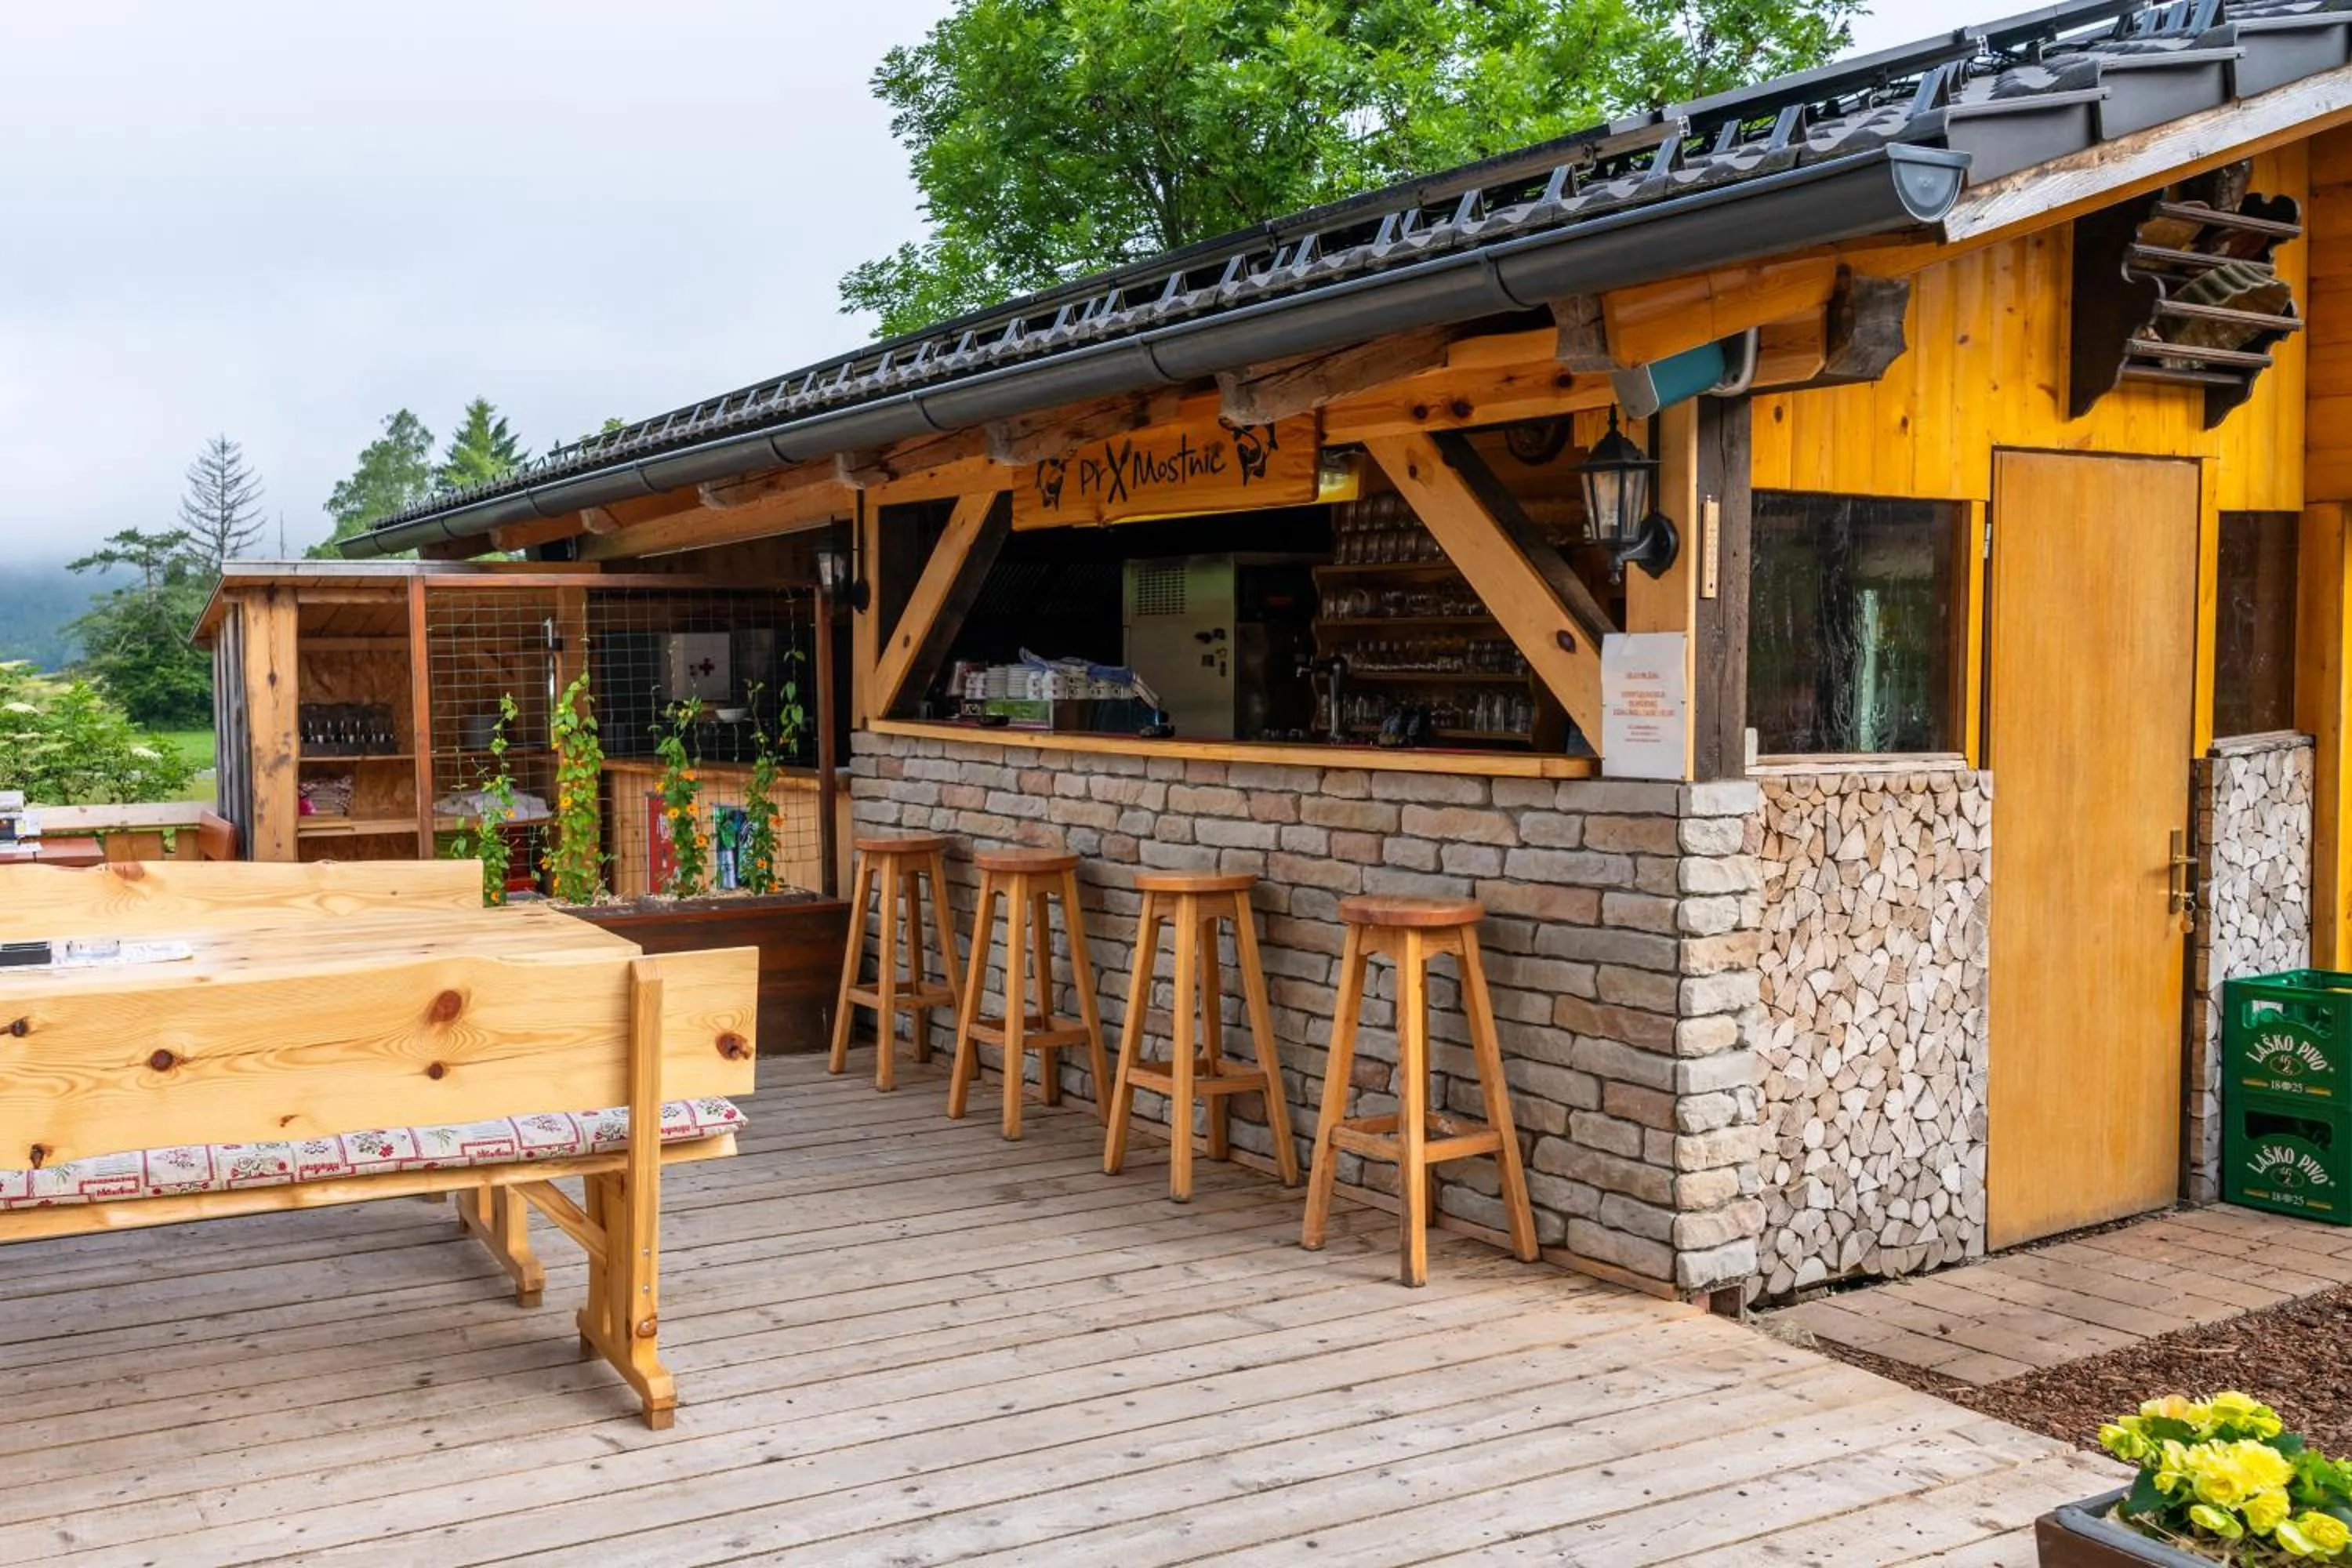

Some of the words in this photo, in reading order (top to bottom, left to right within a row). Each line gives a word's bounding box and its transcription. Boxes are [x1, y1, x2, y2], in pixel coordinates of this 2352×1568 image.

[2245, 1033, 2294, 1064] LAŠKO
[2296, 1040, 2328, 1071] PIVO
[2246, 1145, 2295, 1174] LAŠKO
[2296, 1153, 2328, 1185] PIVO
